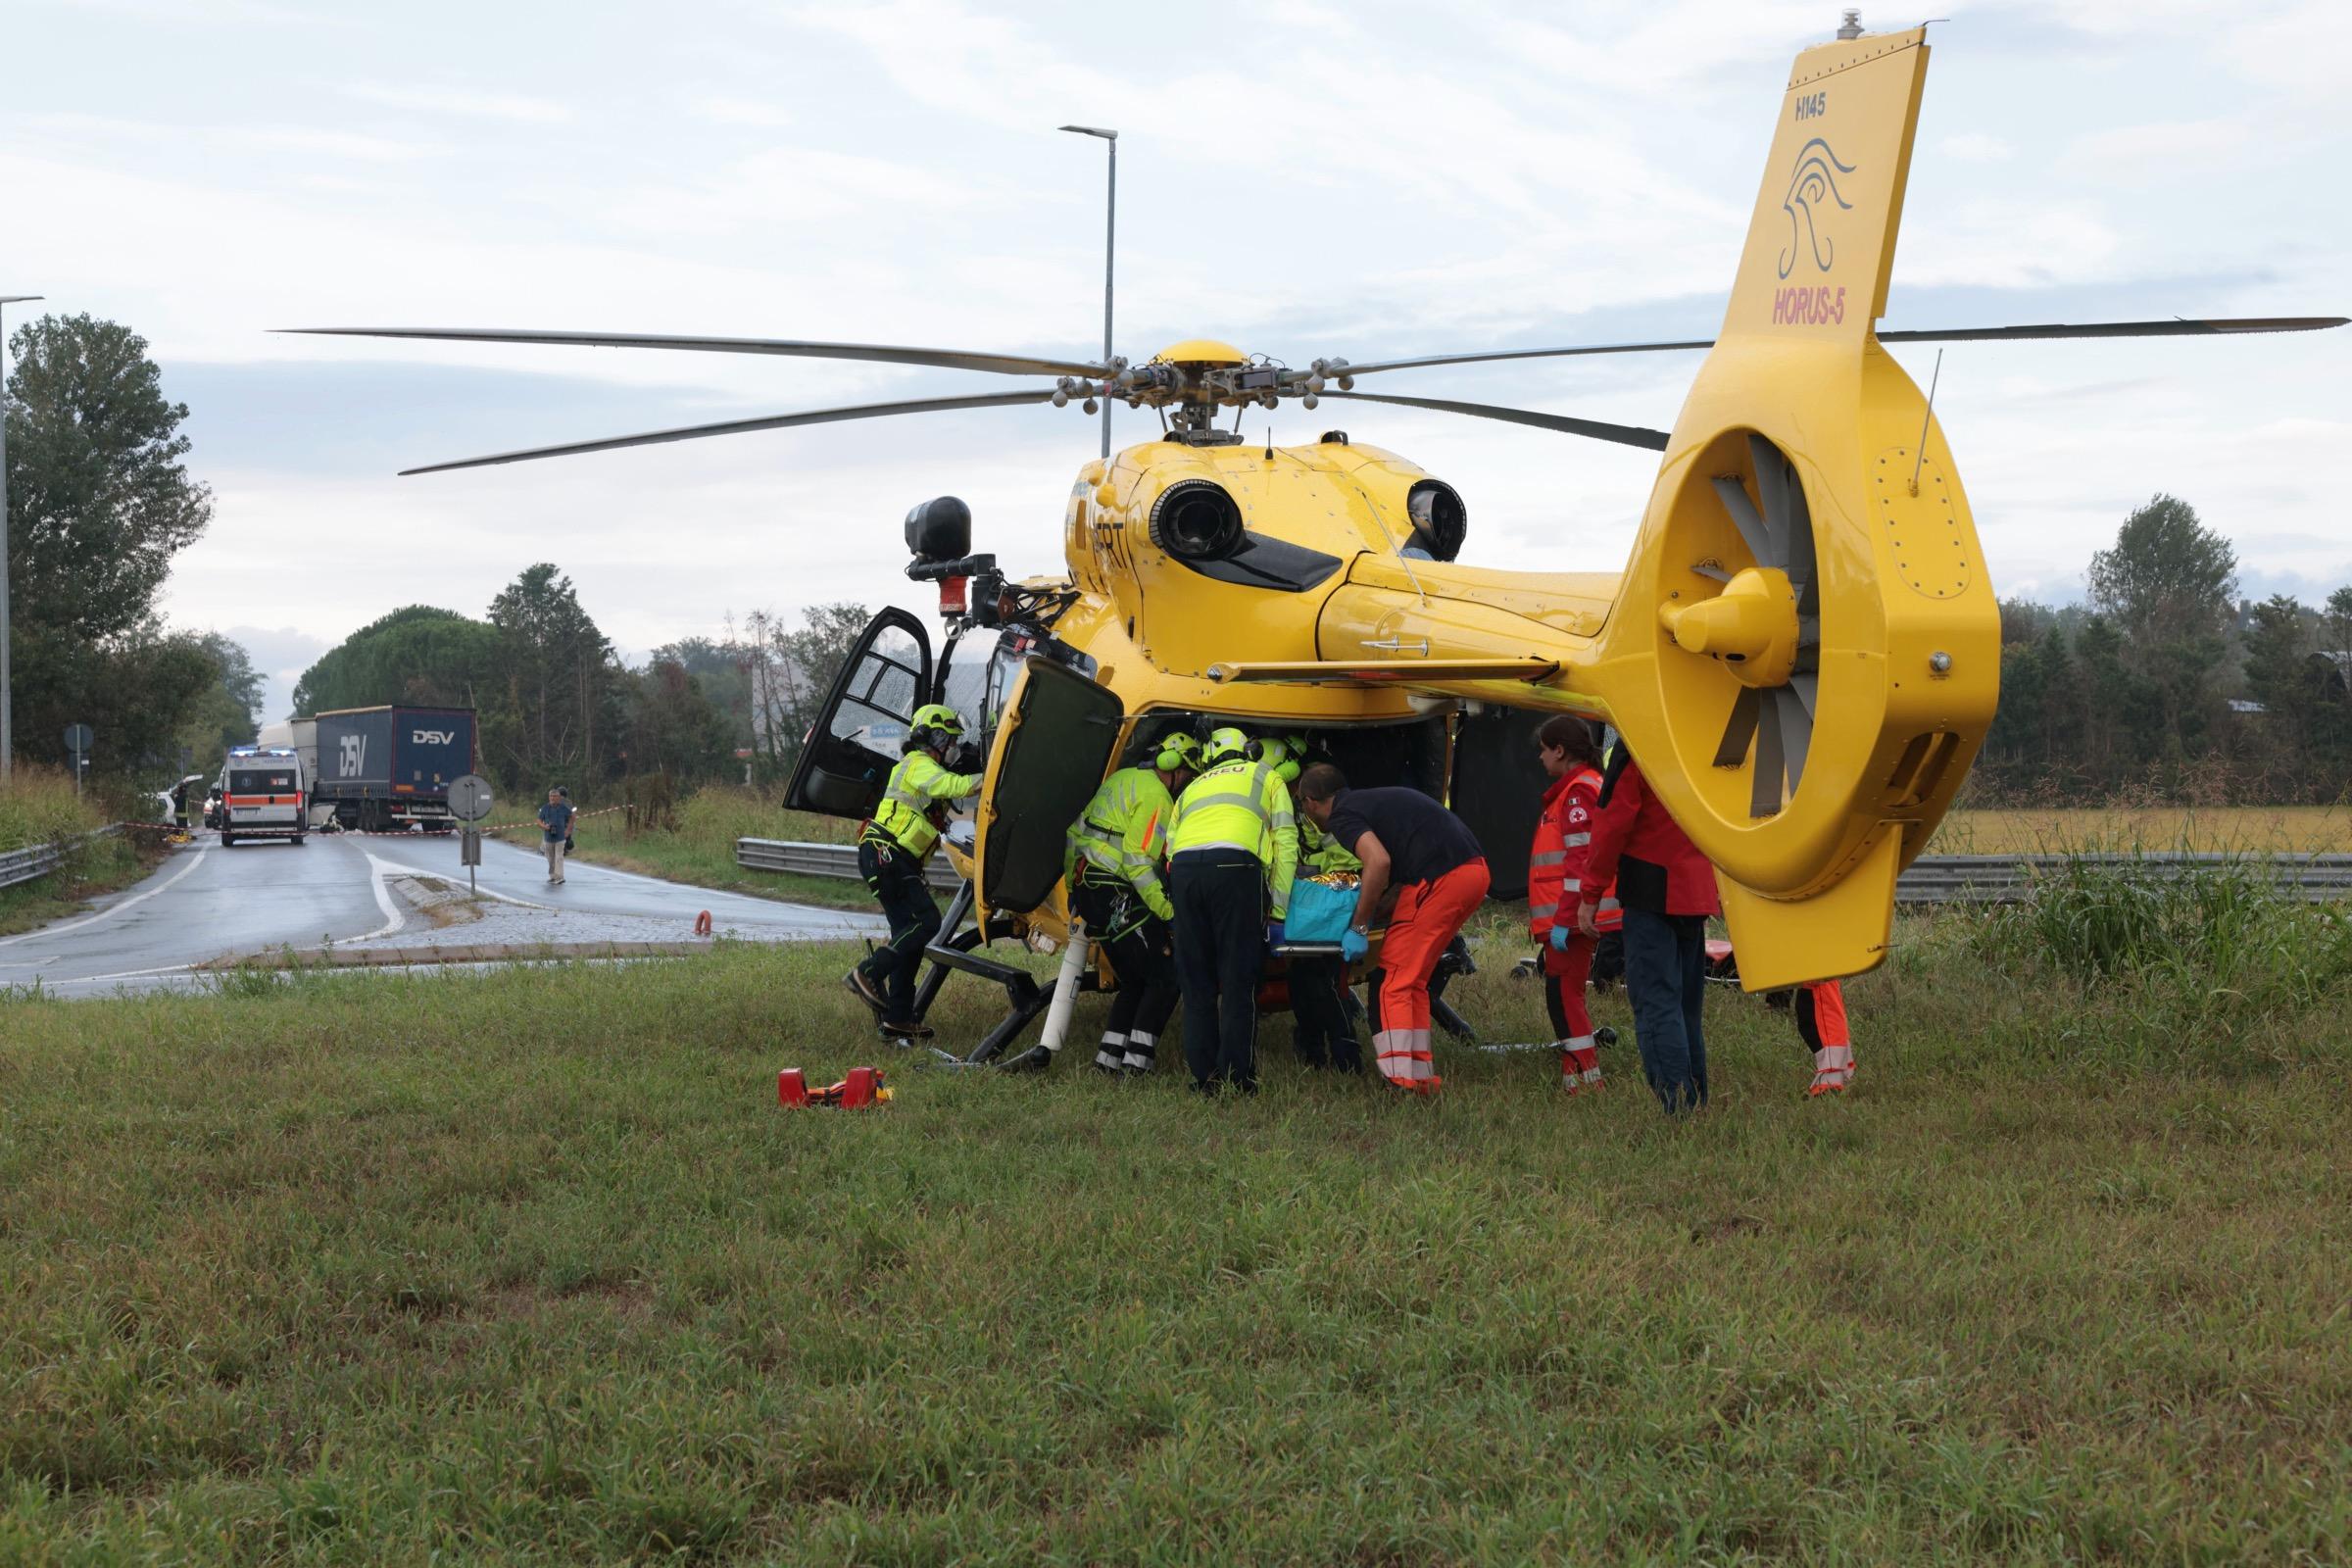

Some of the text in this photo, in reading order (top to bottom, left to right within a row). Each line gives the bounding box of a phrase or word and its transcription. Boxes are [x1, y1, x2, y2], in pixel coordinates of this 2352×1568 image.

[1795, 91, 1826, 122] H145
[1772, 286, 1846, 325] HORUS-5
[413, 730, 455, 745] DSV
[339, 734, 368, 777] DSV
